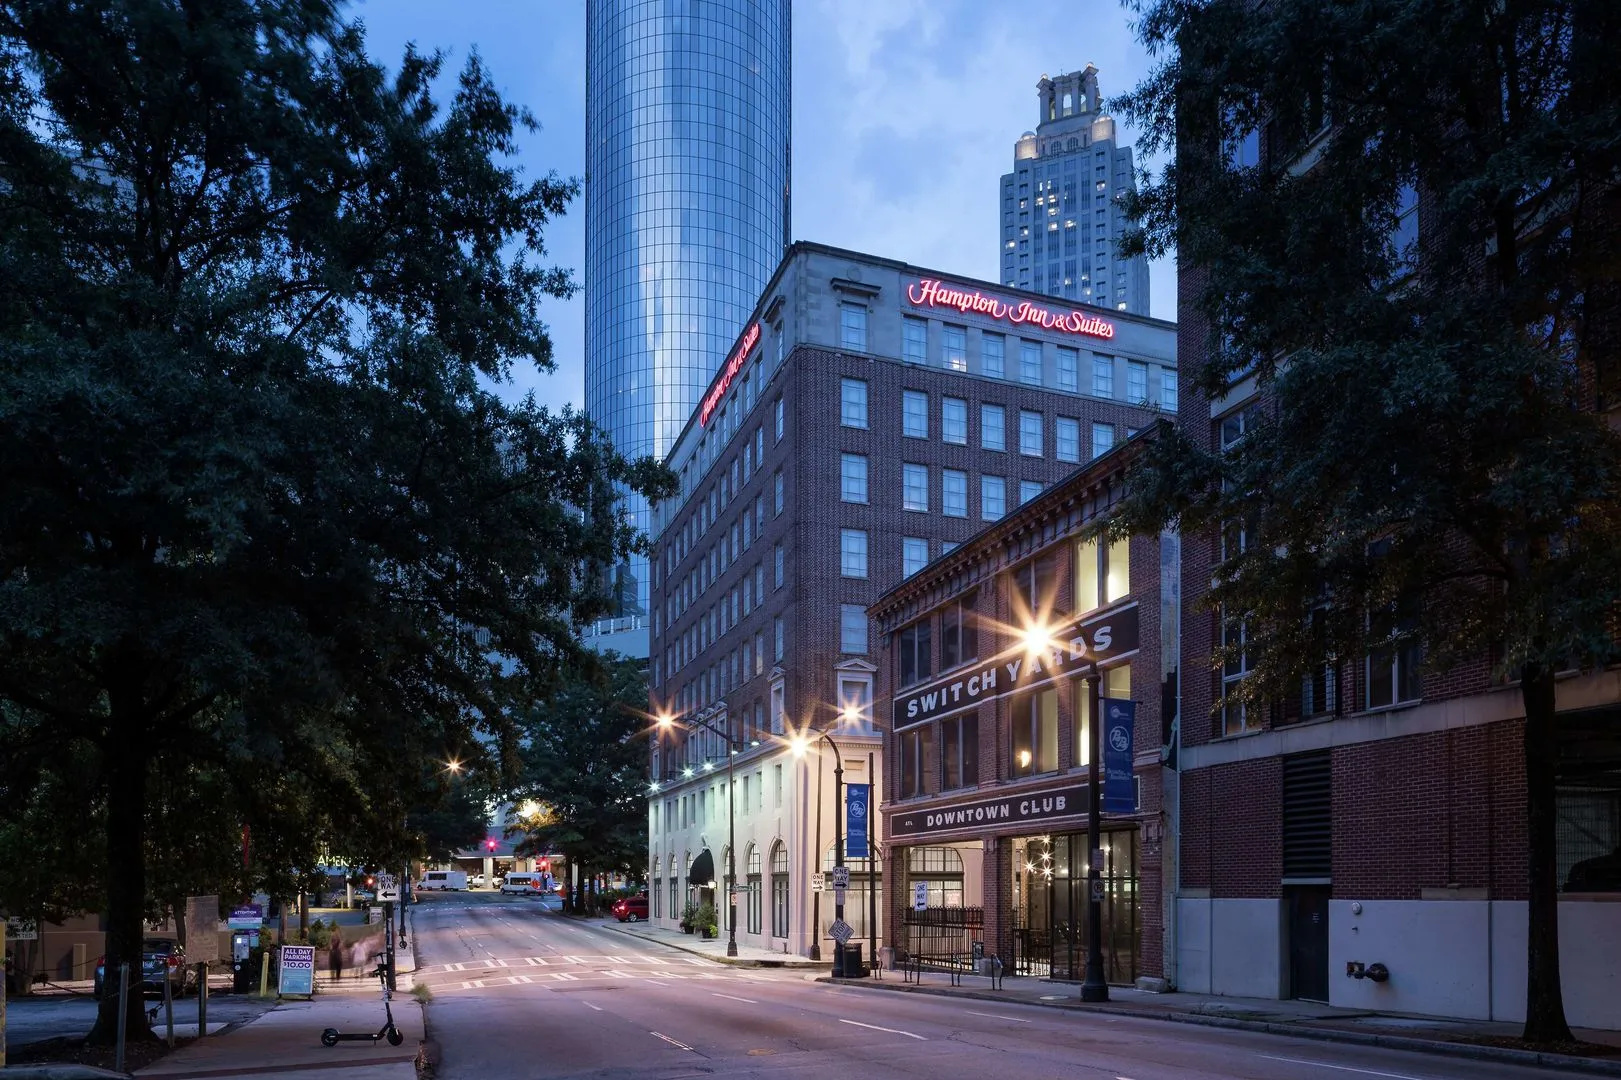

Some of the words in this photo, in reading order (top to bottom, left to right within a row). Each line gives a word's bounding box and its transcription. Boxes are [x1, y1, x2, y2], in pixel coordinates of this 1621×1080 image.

[908, 279, 1006, 318] Hampton
[1008, 302, 1055, 328] Inn
[1066, 311, 1114, 338] Suites
[907, 667, 997, 718] SWITCH
[1006, 625, 1113, 683] YARDS
[926, 804, 1010, 827] DOWNTOWN
[1019, 796, 1067, 816] CLUB
[380, 875, 396, 883] ONE
[833, 922, 846, 939] STOP
